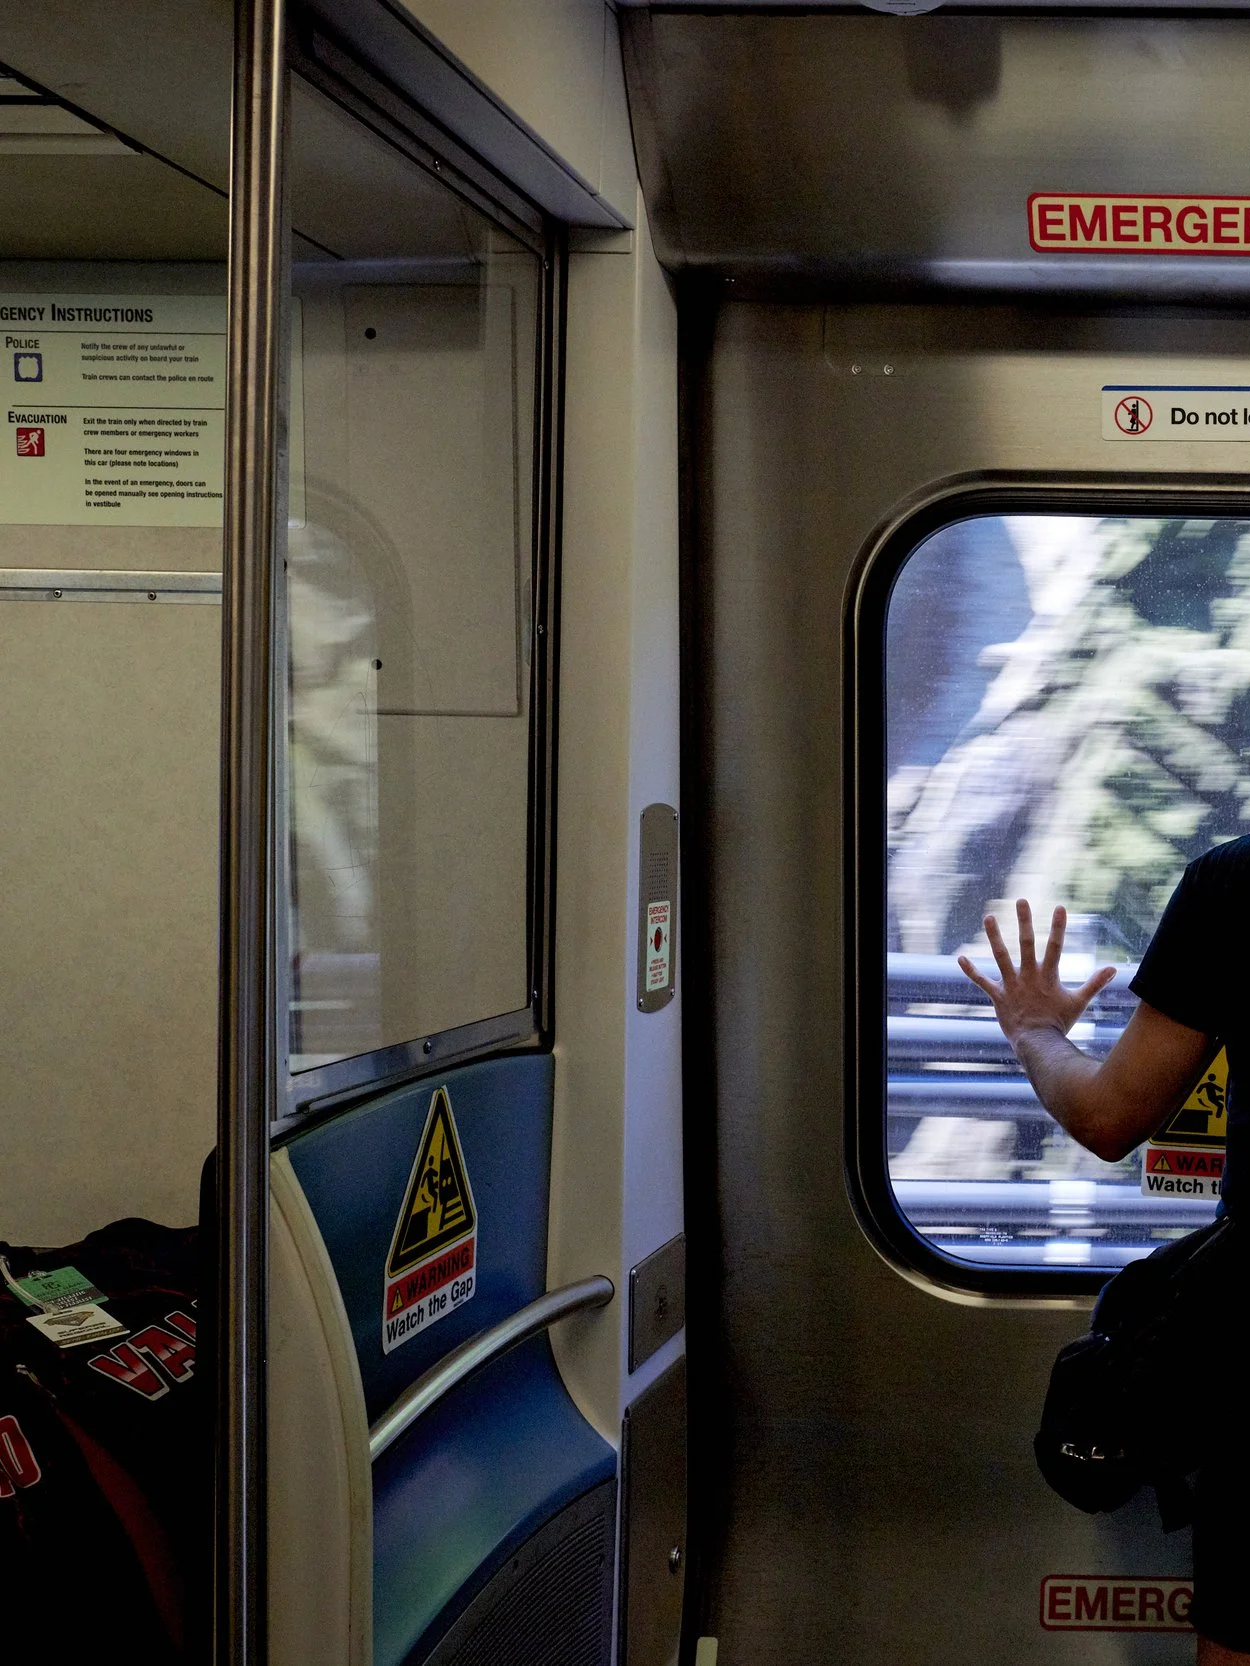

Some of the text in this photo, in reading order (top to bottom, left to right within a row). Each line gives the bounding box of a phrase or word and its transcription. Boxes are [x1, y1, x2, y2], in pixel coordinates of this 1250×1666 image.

[0, 307, 45, 321] GENCY
[124, 418, 137, 426] only
[184, 419, 191, 427] by
[1171, 408, 1199, 425] Do
[1205, 408, 1238, 425] not
[110, 460, 131, 468] (please
[149, 460, 178, 468] locations)
[95, 490, 117, 498] opened
[119, 490, 146, 498] manually
[160, 491, 184, 499] opening
[1176, 1156, 1222, 1173] WAR
[1147, 1176, 1203, 1194] Watch
[405, 1247, 469, 1300] WARNING
[386, 1276, 473, 1343] Watch the Gap
[1048, 1586, 1193, 1623] EMERG
